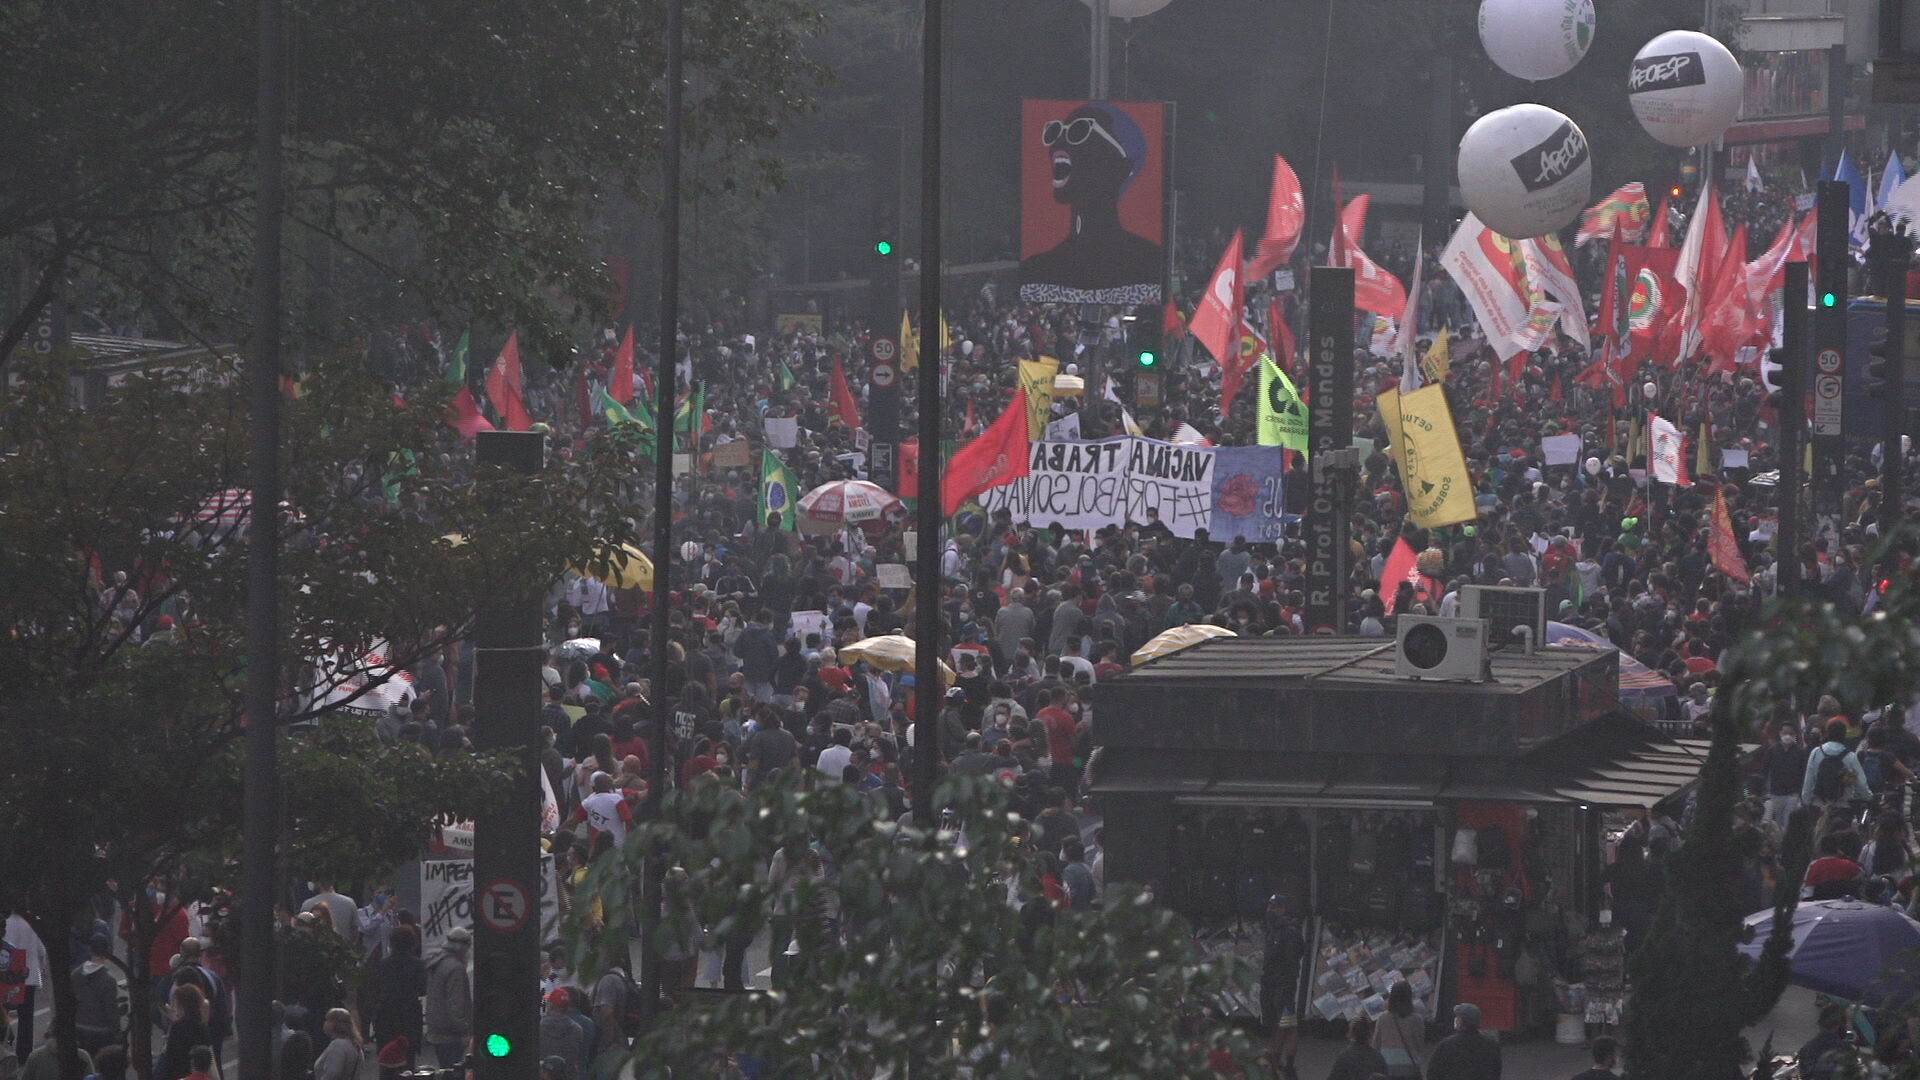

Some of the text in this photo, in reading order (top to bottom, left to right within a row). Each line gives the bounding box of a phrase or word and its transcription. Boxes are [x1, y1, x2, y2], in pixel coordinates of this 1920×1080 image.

[876, 342, 892, 354] 50
[1821, 353, 1837, 365] 50
[1314, 336, 1335, 427] Mendes
[1312, 521, 1331, 576] Prof.
[1311, 586, 1330, 606] R.
